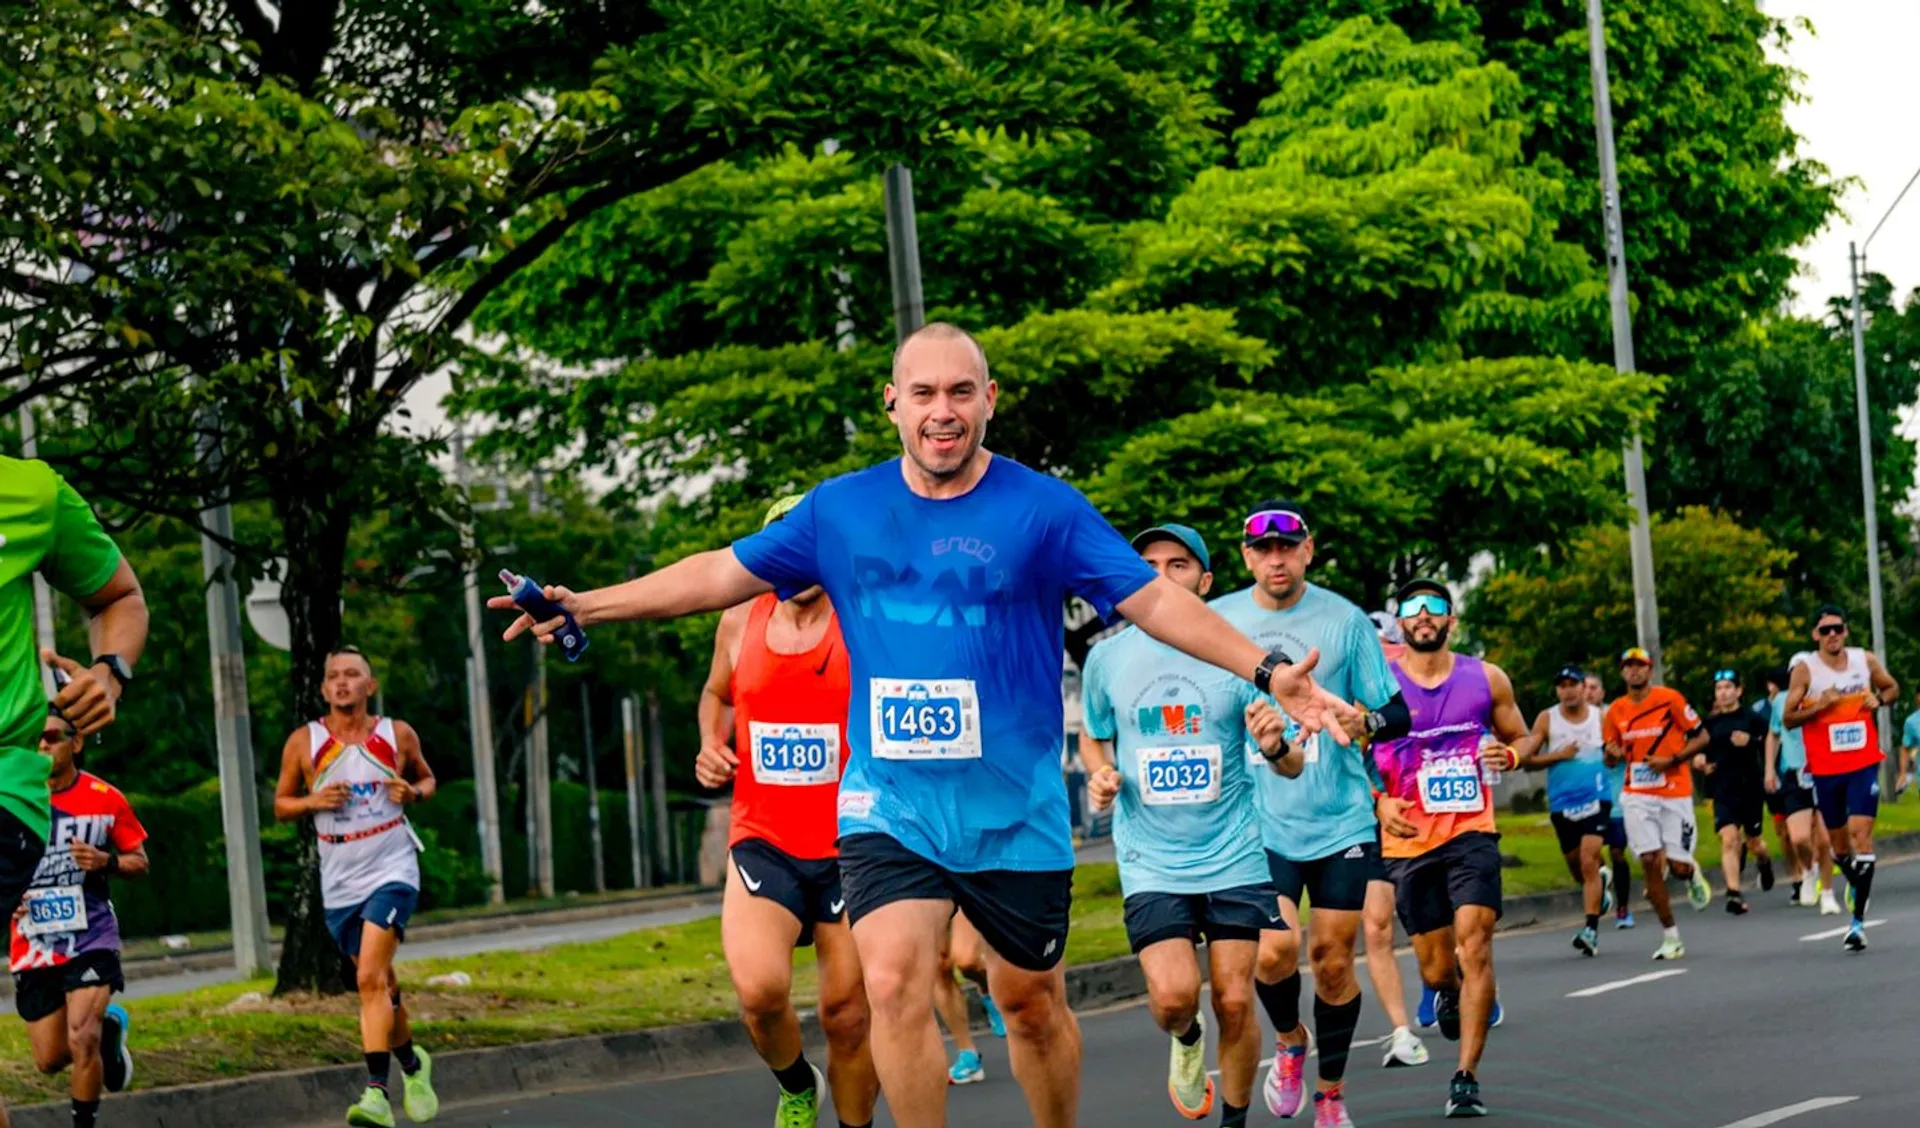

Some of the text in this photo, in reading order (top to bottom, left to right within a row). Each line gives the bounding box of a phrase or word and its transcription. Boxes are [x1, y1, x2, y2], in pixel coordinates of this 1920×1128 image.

[885, 704, 957, 736] 1463
[1138, 703, 1202, 735] MMC
[763, 742, 823, 768] 3180
[1151, 763, 1208, 788] 2032
[1430, 779, 1476, 799] 4158
[32, 900, 74, 921] 3635
